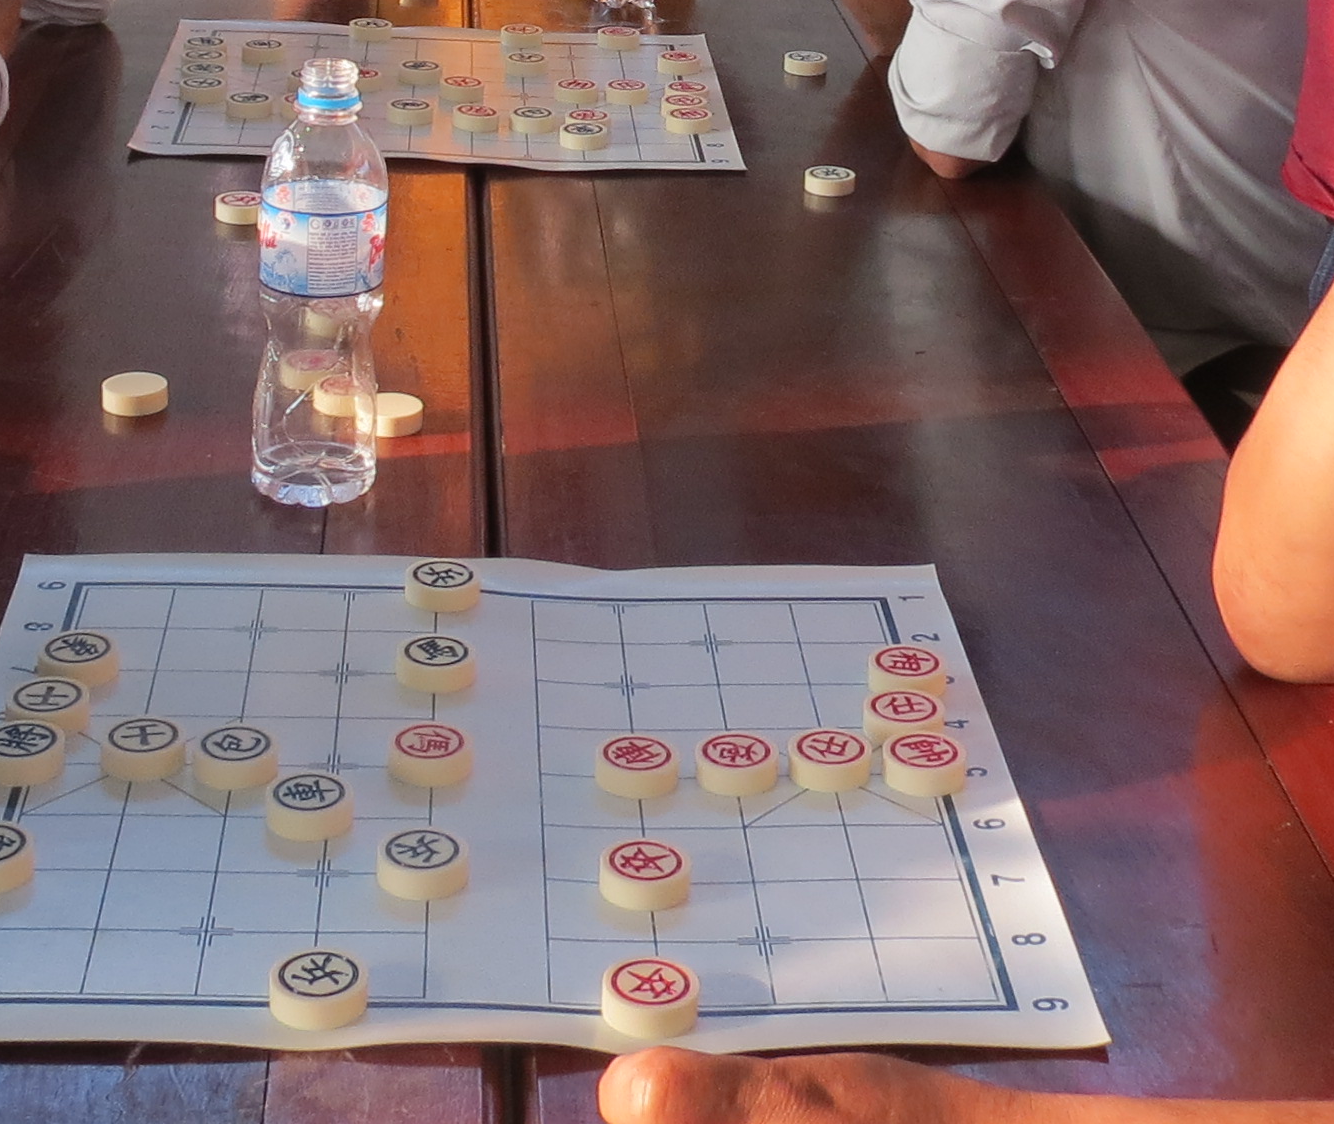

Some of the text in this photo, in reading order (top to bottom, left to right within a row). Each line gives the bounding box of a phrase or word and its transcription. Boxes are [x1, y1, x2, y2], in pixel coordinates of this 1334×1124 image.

[910, 632, 941, 643] 2
[972, 818, 1006, 831] 6
[990, 874, 1026, 887] 7
[1011, 932, 1047, 947] 8
[1032, 996, 1070, 1012] 9
